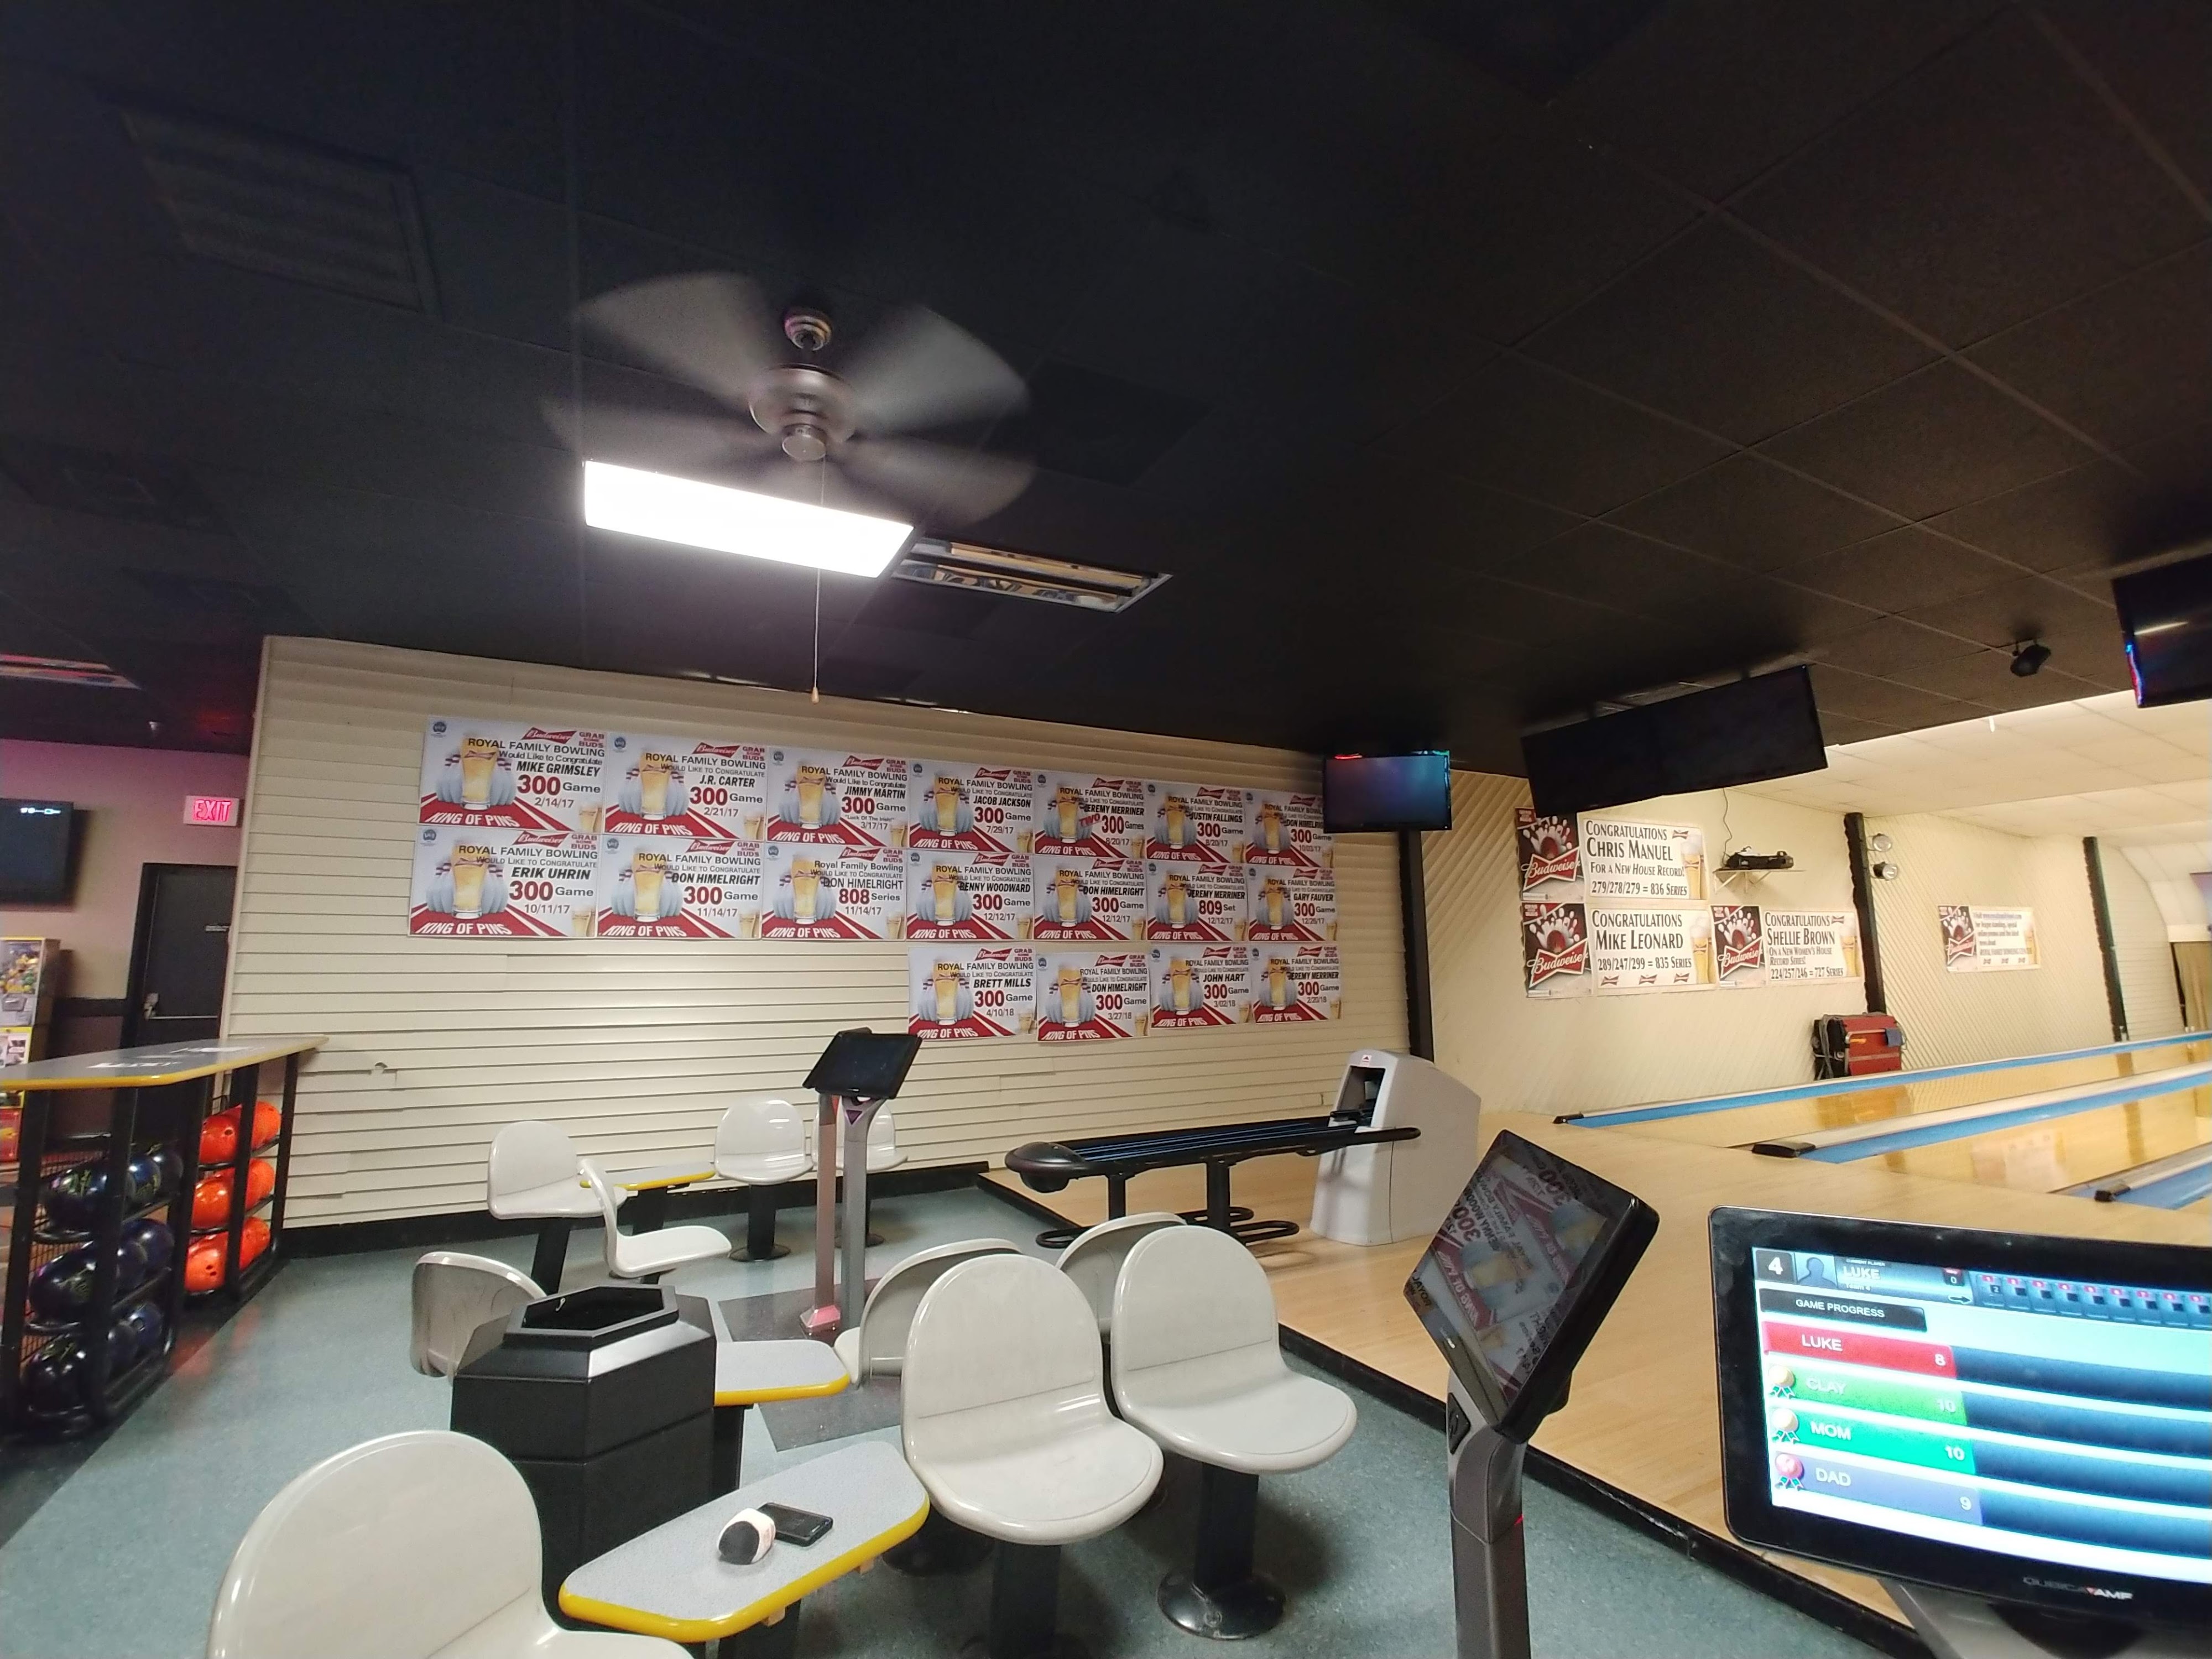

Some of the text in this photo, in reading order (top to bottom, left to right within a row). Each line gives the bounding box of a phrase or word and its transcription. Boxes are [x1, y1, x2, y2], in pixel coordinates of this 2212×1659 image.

[468, 738, 604, 757] ROYAL FAMILY BOWLING
[516, 761, 601, 778] MIKE GRIMSLEY
[517, 775, 601, 795] 300 Game
[700, 775, 755, 787] J.R. CARTER
[690, 786, 763, 806] 300 Game
[845, 786, 906, 799] JIMMY MARTIN
[535, 797, 574, 808] 2/14/17
[841, 797, 906, 815] 300 Game
[973, 796, 1031, 807] JACOB JACKSON
[194, 800, 232, 822] EXIT
[704, 807, 739, 817] 2/21/17
[974, 806, 1031, 823] 300 Game
[1112, 806, 1145, 816] MERRINER
[1190, 812, 1243, 822] JUSTIN FALLINGS
[1079, 813, 1100, 827] TWO
[1102, 816, 1144, 834] 300 Games
[987, 826, 1013, 834] 7/29/17
[1197, 822, 1220, 837] 300
[1291, 829, 1311, 843] 300
[1586, 820, 1667, 841] CONGRATULATIONS
[1587, 837, 1673, 861] CHRIS MANUEL
[512, 867, 591, 880] ERIK UHRIN
[841, 862, 868, 871] Family
[870, 863, 903, 873] Bowling
[1521, 859, 1581, 878] Budweiser
[1591, 862, 1685, 877] FOR A NEW HOUSE RECORD!
[671, 873, 761, 885] DON HIMELRIGHT
[823, 879, 904, 890] DON HIMELRIGHT
[509, 881, 594, 901] 300 Game
[987, 883, 1031, 892] WOODWARD
[1100, 886, 1145, 896] HIMELRIGHT
[1592, 881, 1640, 894] 279/278/279
[1651, 885, 1664, 895] 836
[1666, 886, 1687, 896] SERIES
[684, 886, 758, 905] 300 Game
[839, 889, 870, 904] 808
[973, 894, 1003, 910] 300
[524, 904, 571, 914] 10/11/17
[845, 906, 881, 915] 11/14/17
[1092, 897, 1119, 912] 300
[1199, 900, 1222, 915] 809
[1294, 902, 1315, 917] 300
[697, 909, 737, 917] 11/14/17
[1592, 910, 1682, 927] CONGRATULATIONS
[1765, 912, 1830, 926] CONGRATULATIONS
[1596, 930, 1683, 950] MIKE LEONARD
[1767, 928, 1835, 946] SHELLIE BROWN
[1527, 951, 1589, 975] Budweiser
[1598, 957, 1645, 971] 289/247/299
[1655, 958, 1669, 969] 835
[1671, 956, 1692, 968] SERIES
[1718, 947, 1763, 967] Budweiser
[1815, 967, 1825, 977] 727
[1826, 967, 1844, 977] SERIES
[973, 978, 1031, 988] BRETT MILLS
[1092, 983, 1147, 993] DON HIMELRIGHT
[1298, 982, 1319, 995] 300
[974, 990, 1004, 1007] 300
[1204, 984, 1227, 999] 300
[1095, 994, 1123, 1010] 300
[1768, 1256, 1783, 1275] 4
[1843, 1266, 1881, 1280] LUKE
[1796, 1299, 1885, 1318] GAME PROGRESS
[1802, 1334, 1946, 1366] LUKE 8
[1806, 1377, 1957, 1413] CLAY 10
[1810, 1421, 1965, 1461] MOM 10
[1815, 1468, 1972, 1510] DAD 9
